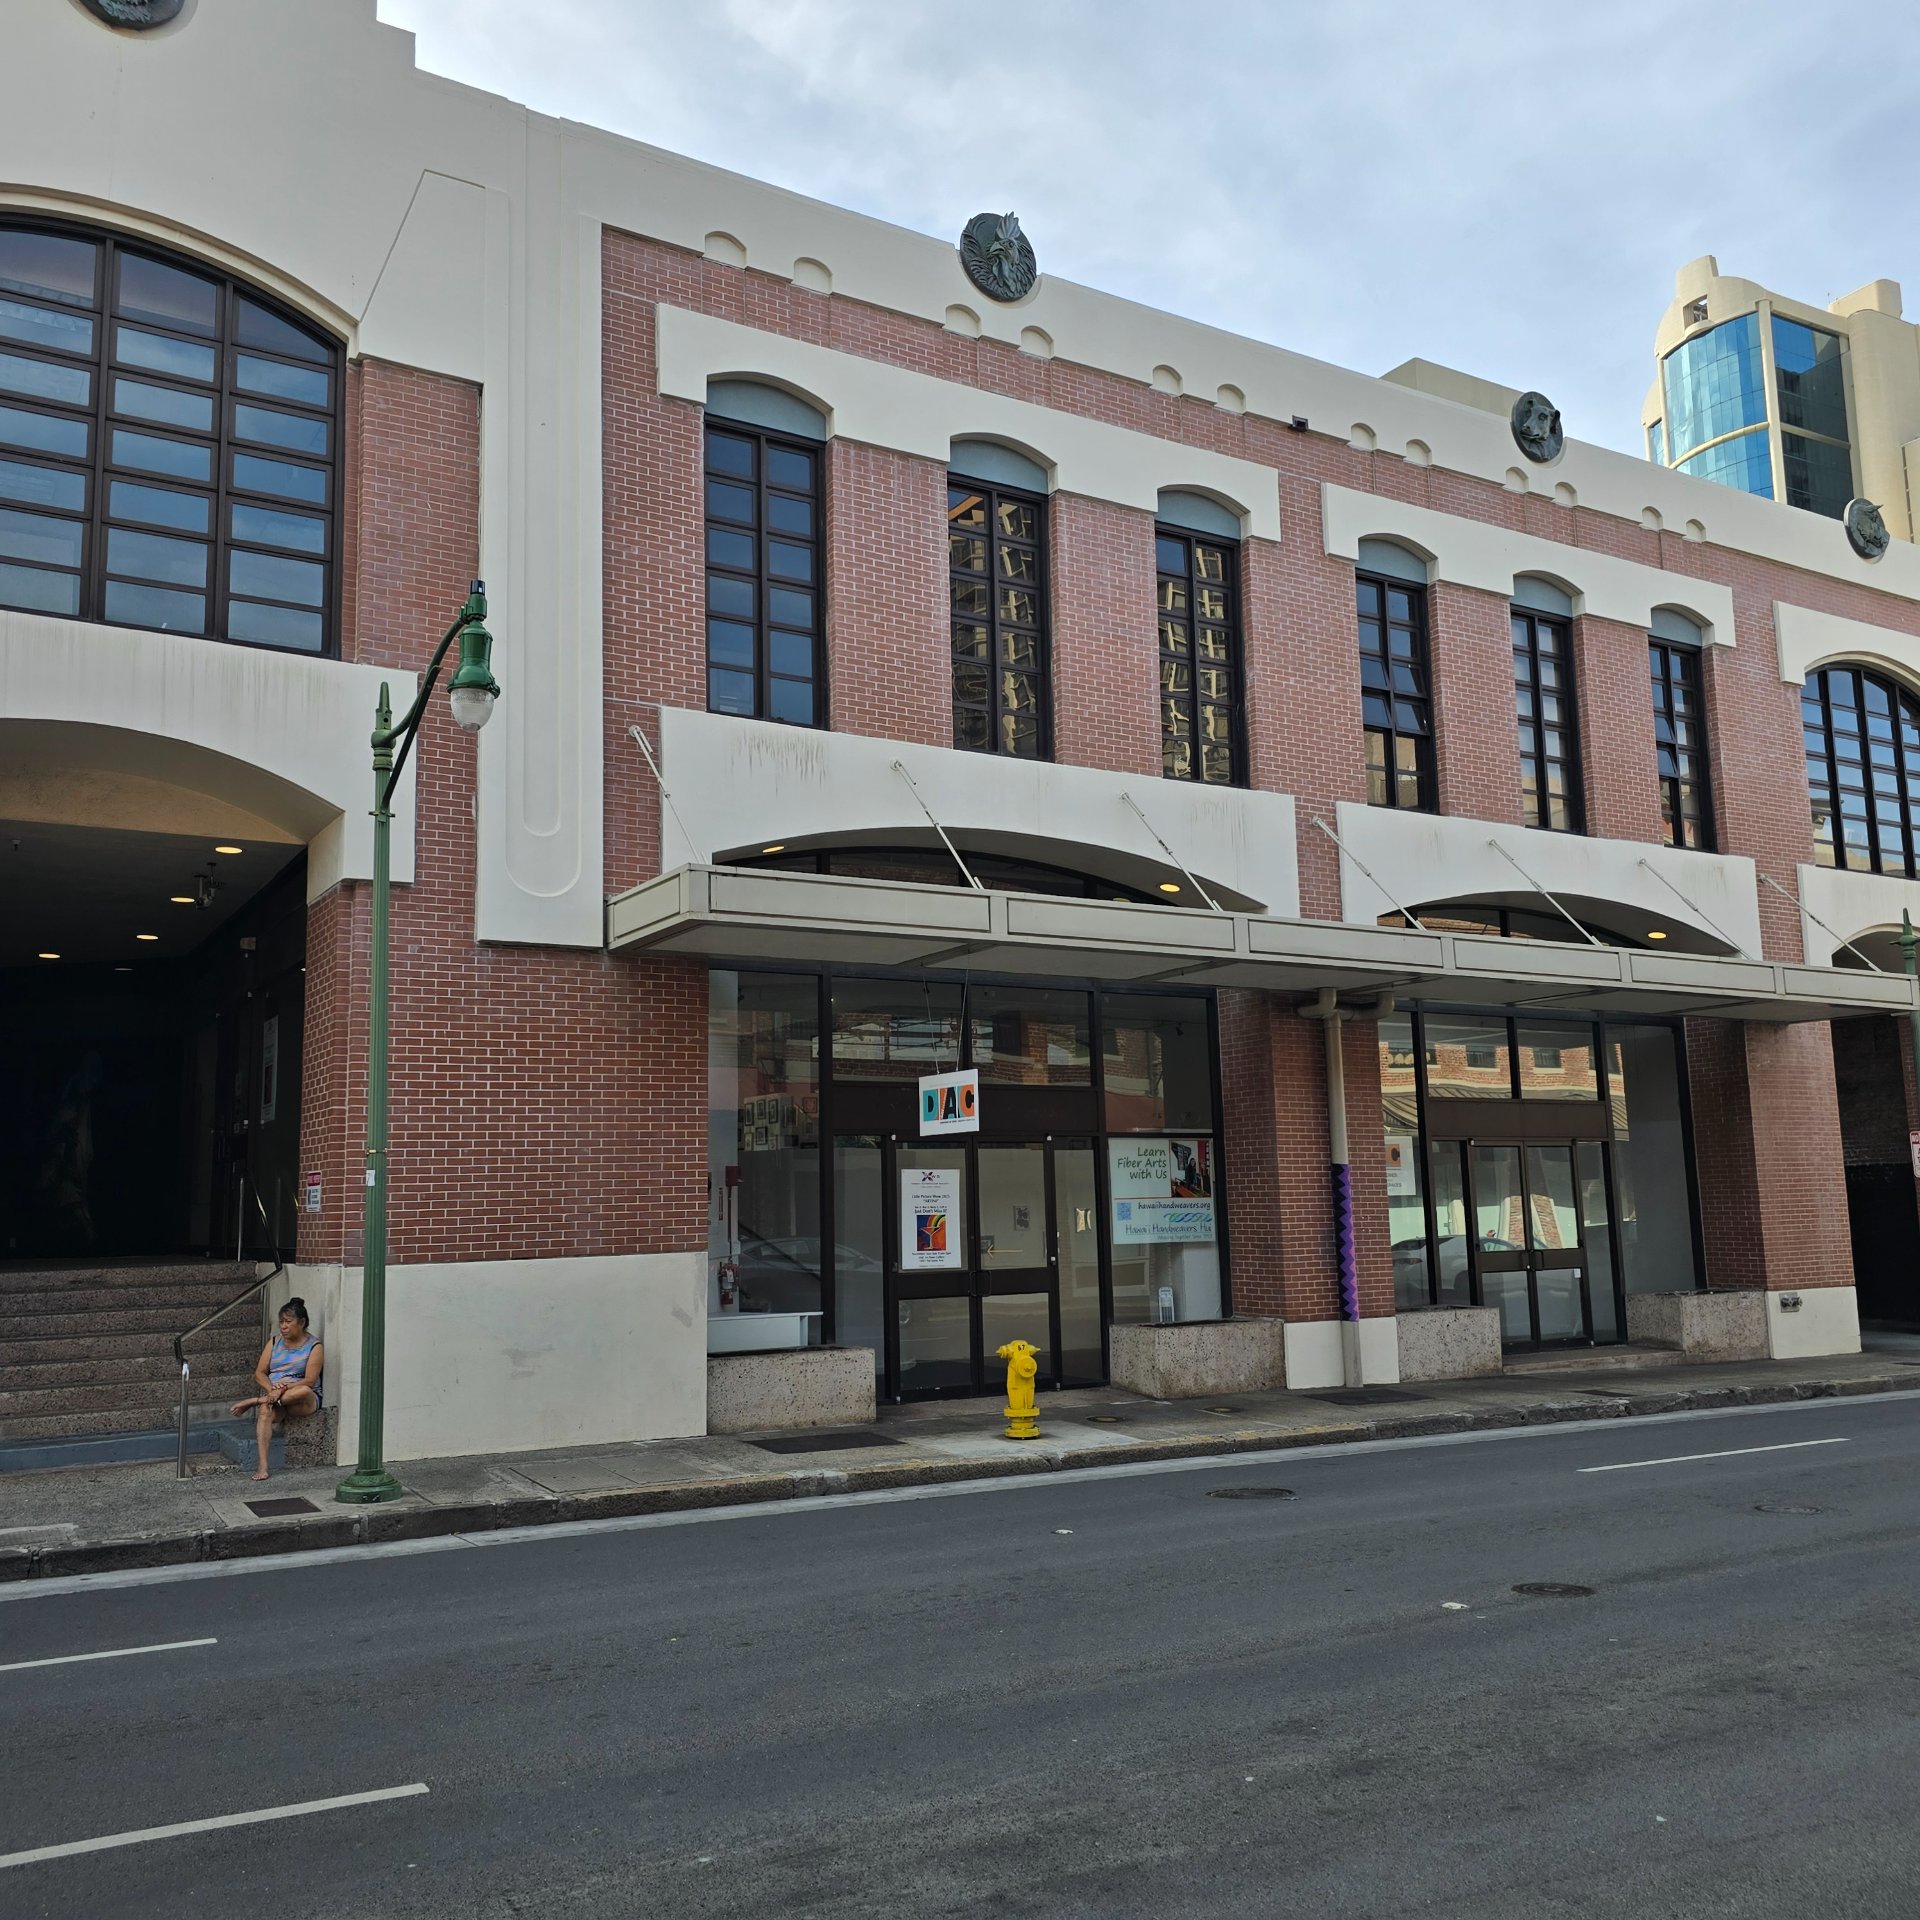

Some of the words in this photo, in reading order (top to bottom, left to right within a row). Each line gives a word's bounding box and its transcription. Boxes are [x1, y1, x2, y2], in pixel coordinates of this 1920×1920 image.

[922, 1084, 975, 1121] DAC
[1137, 1147, 1166, 1157] Learn
[1117, 1157, 1142, 1169] Fiber
[1144, 1158, 1167, 1168] Arts
[1129, 1168, 1152, 1180] with
[1155, 1169, 1168, 1179] Us
[1138, 1201, 1211, 1211] hawaiihandweavers.org
